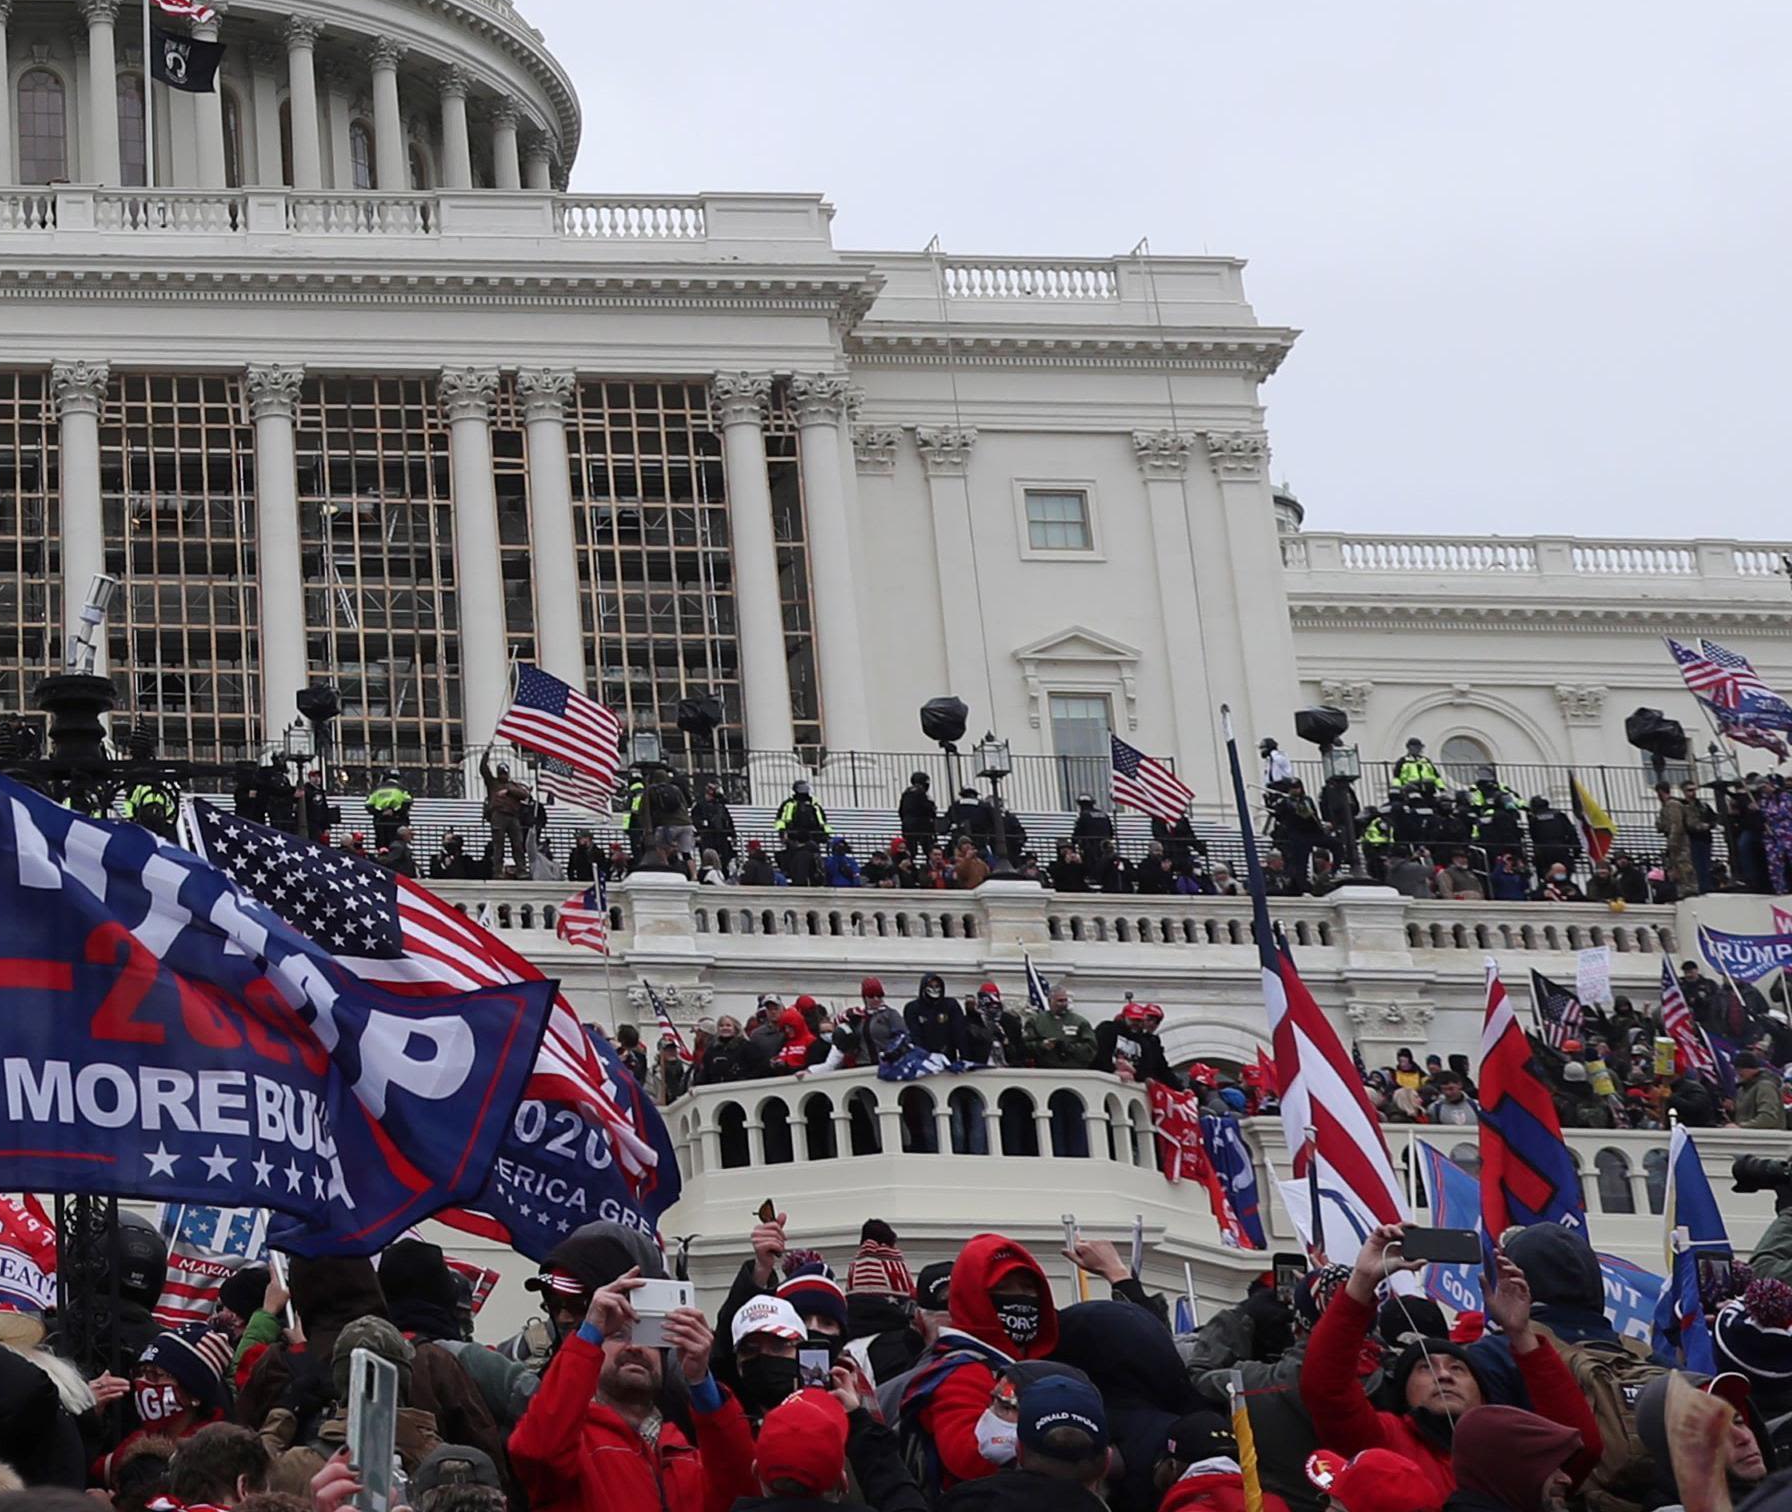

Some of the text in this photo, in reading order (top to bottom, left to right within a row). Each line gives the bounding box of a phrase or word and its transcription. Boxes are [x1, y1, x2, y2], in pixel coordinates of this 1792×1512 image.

[3, 1058, 250, 1136] MORE
[514, 1099, 613, 1170] 020
[495, 1157, 652, 1236] ERICA GRE
[178, 1258, 237, 1279] MAKIN
[1442, 1269, 1476, 1311] GOD
[1035, 1412, 1070, 1430] DONALD
